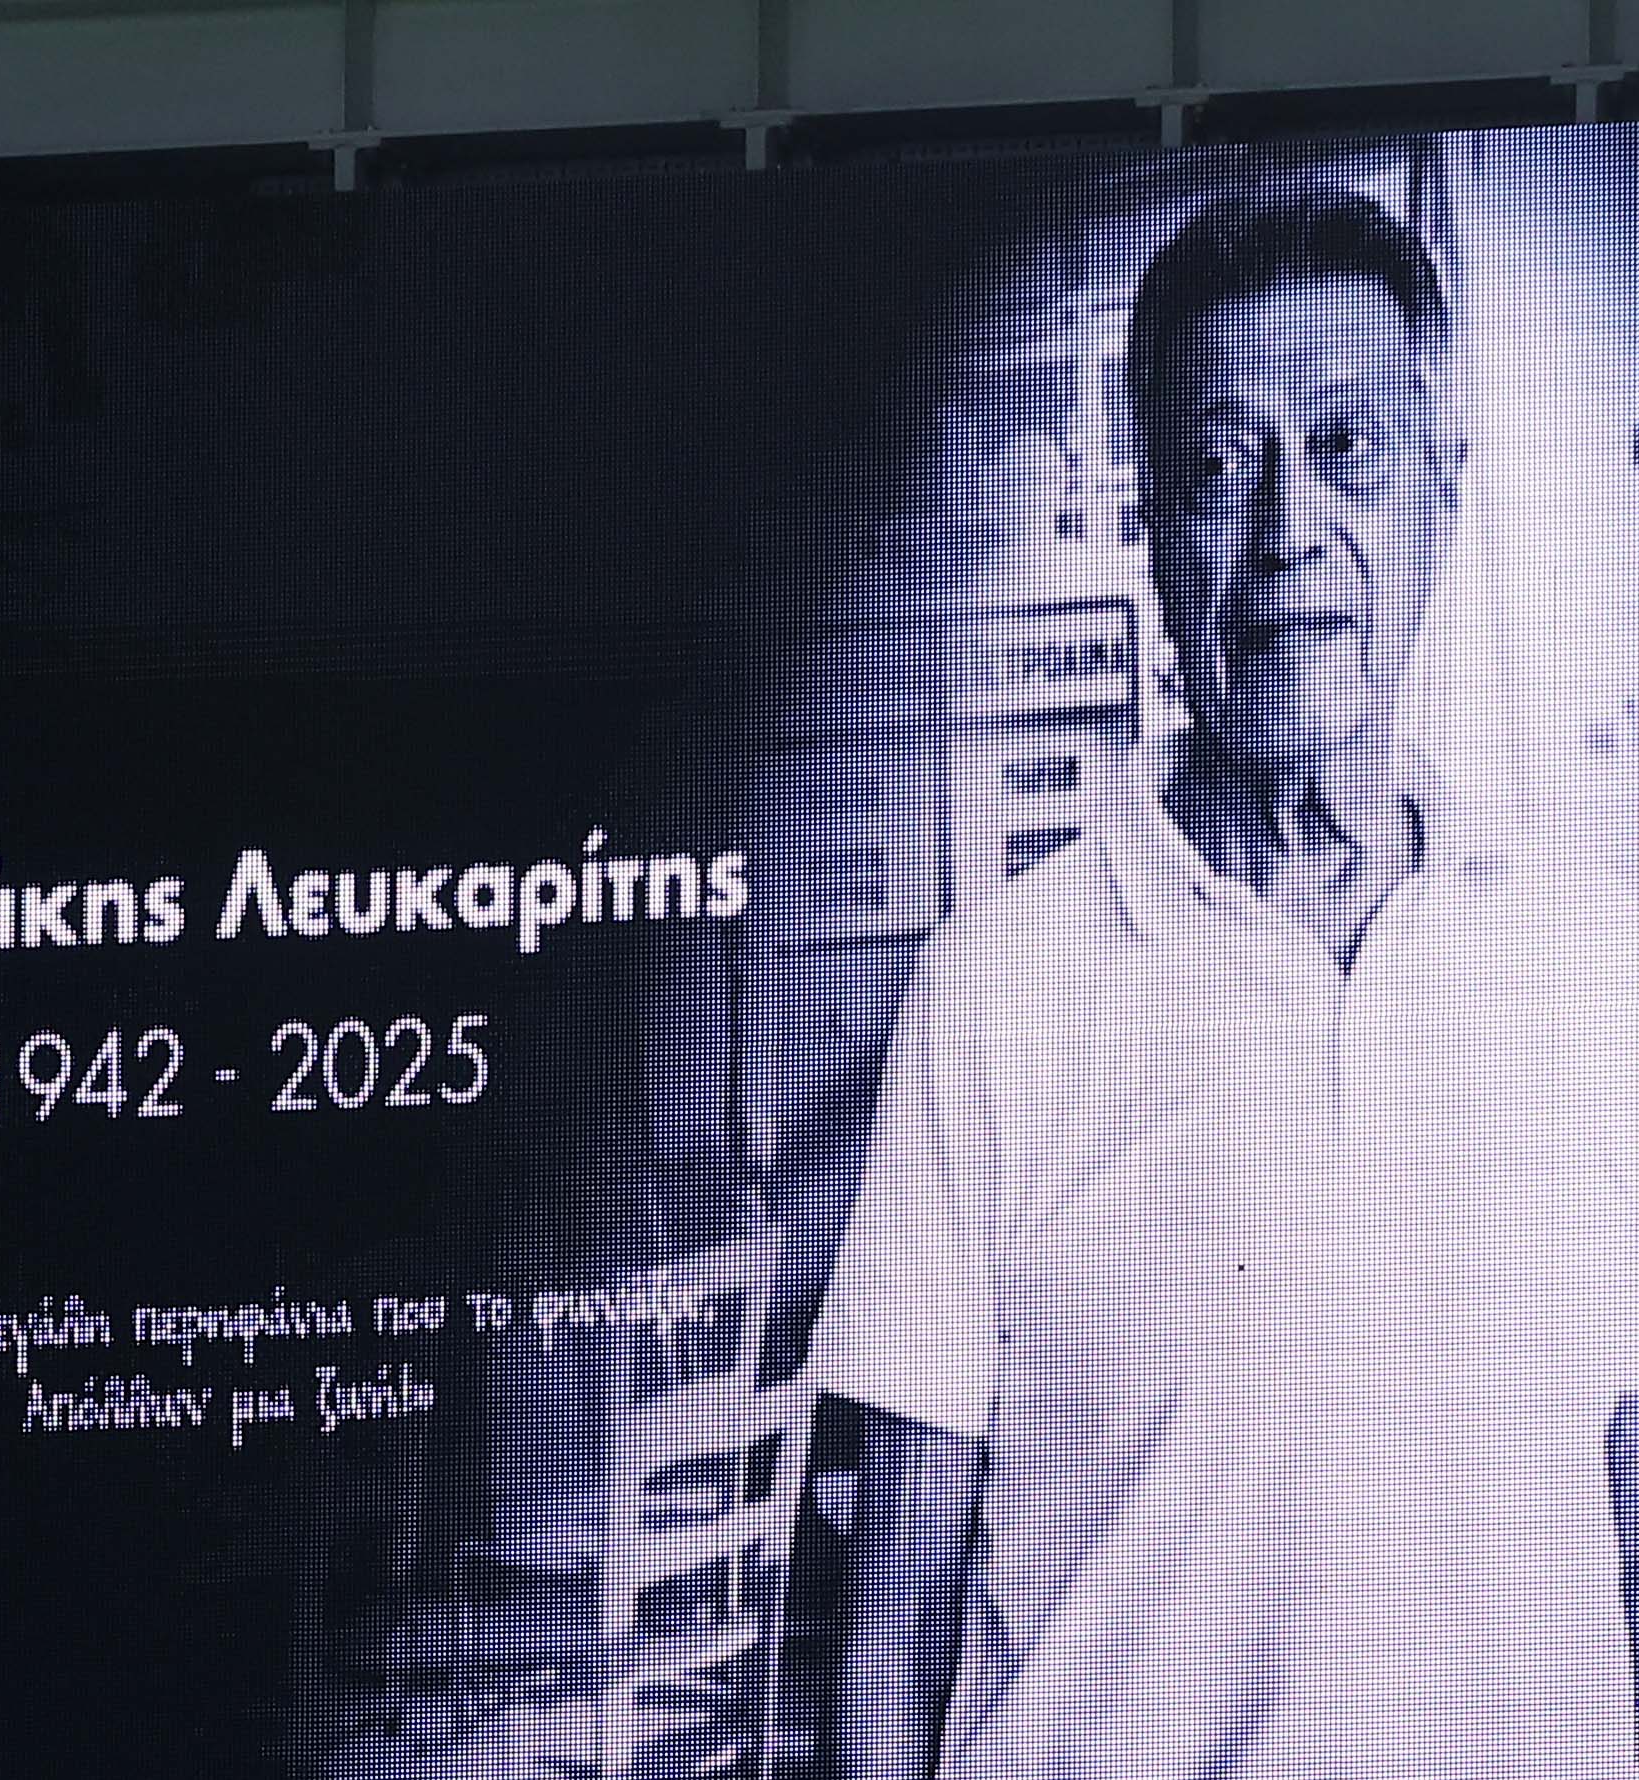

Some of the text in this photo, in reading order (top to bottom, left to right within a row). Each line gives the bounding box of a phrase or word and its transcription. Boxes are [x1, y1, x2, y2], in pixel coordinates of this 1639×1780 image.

[218, 828, 749, 953] Λευκαρίτης
[270, 1014, 489, 1112] 2025
[373, 1296, 447, 1336] που
[464, 1293, 513, 1333] το
[231, 1388, 295, 1449] μια
